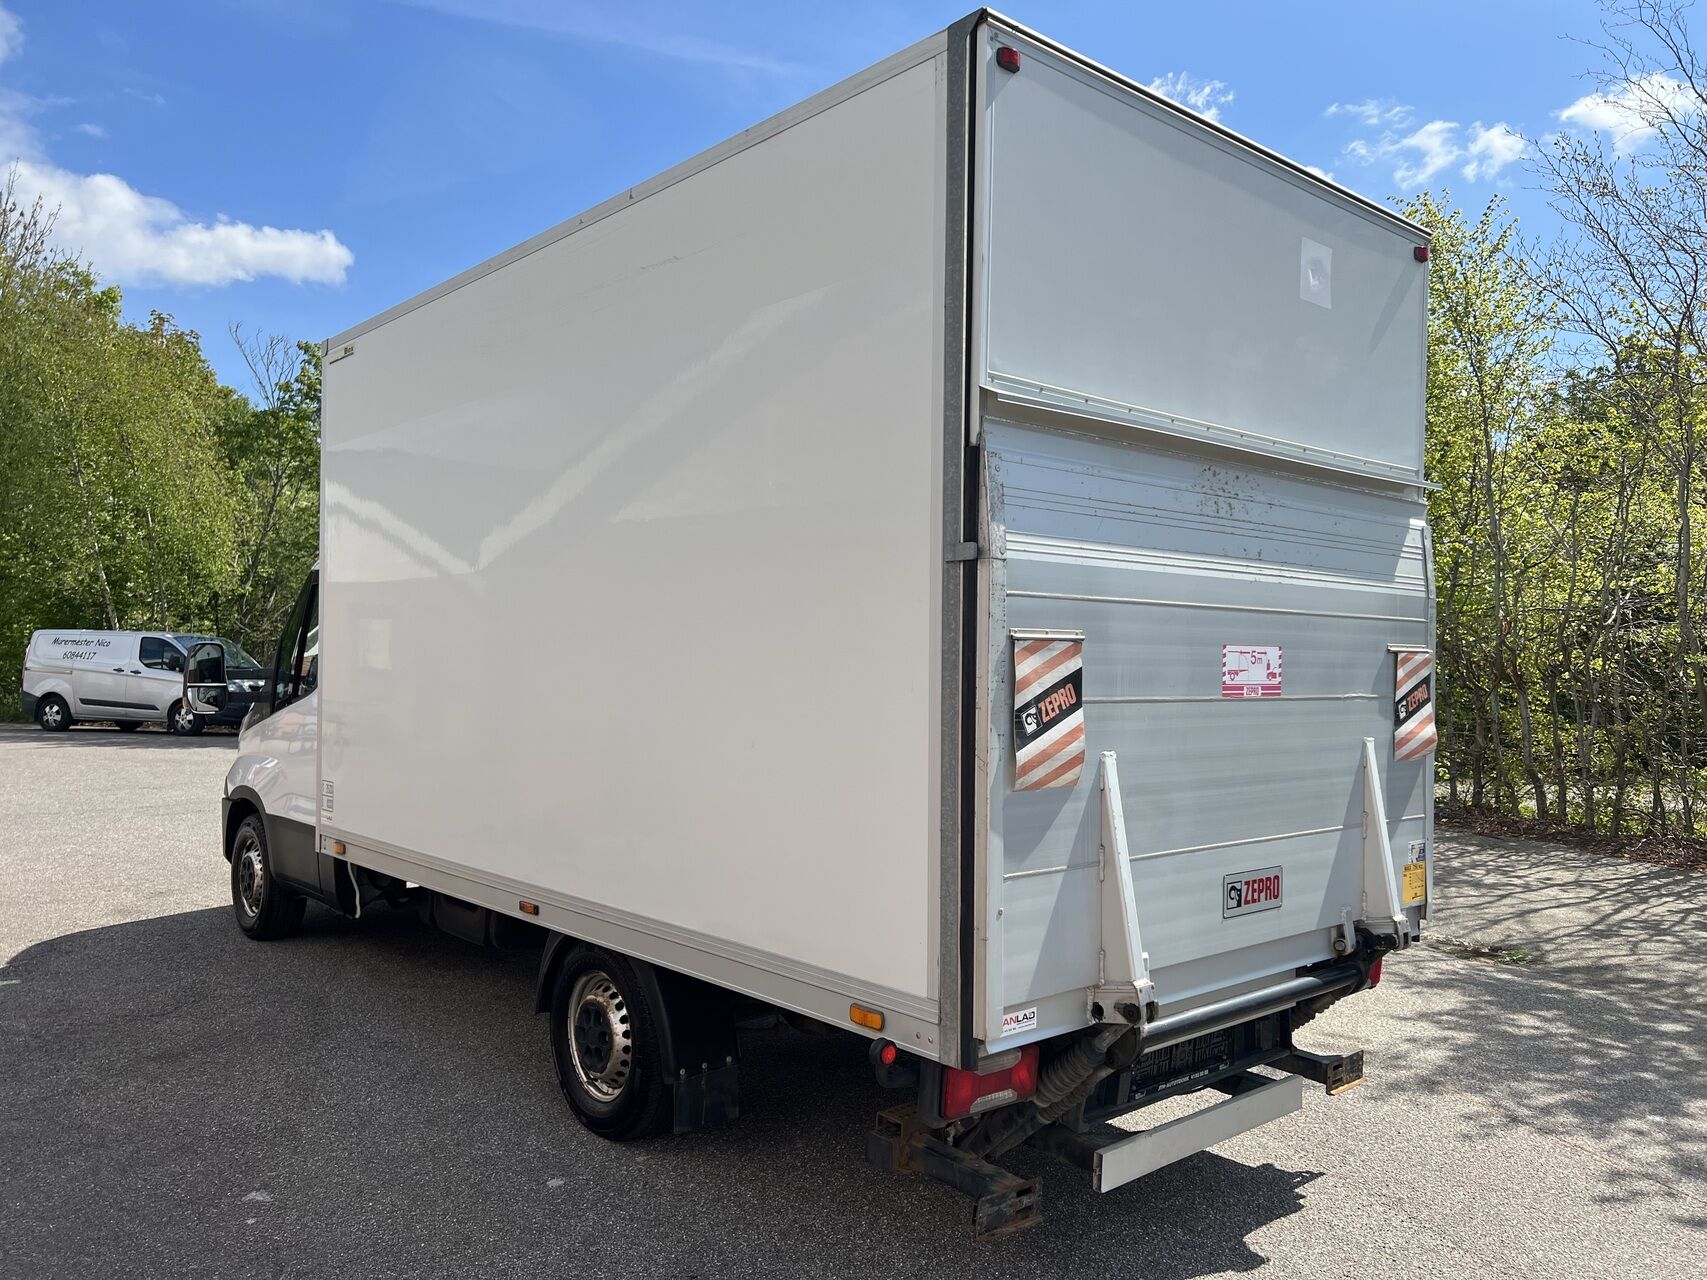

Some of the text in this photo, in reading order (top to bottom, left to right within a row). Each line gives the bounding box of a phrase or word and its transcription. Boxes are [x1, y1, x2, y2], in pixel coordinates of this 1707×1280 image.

[51, 637, 111, 647] Murermester Nico
[62, 650, 97, 660] 60844117
[1038, 683, 1077, 723] ZEPRO
[1407, 684, 1428, 712] ZEPRO
[1244, 875, 1280, 905] ZEPRO
